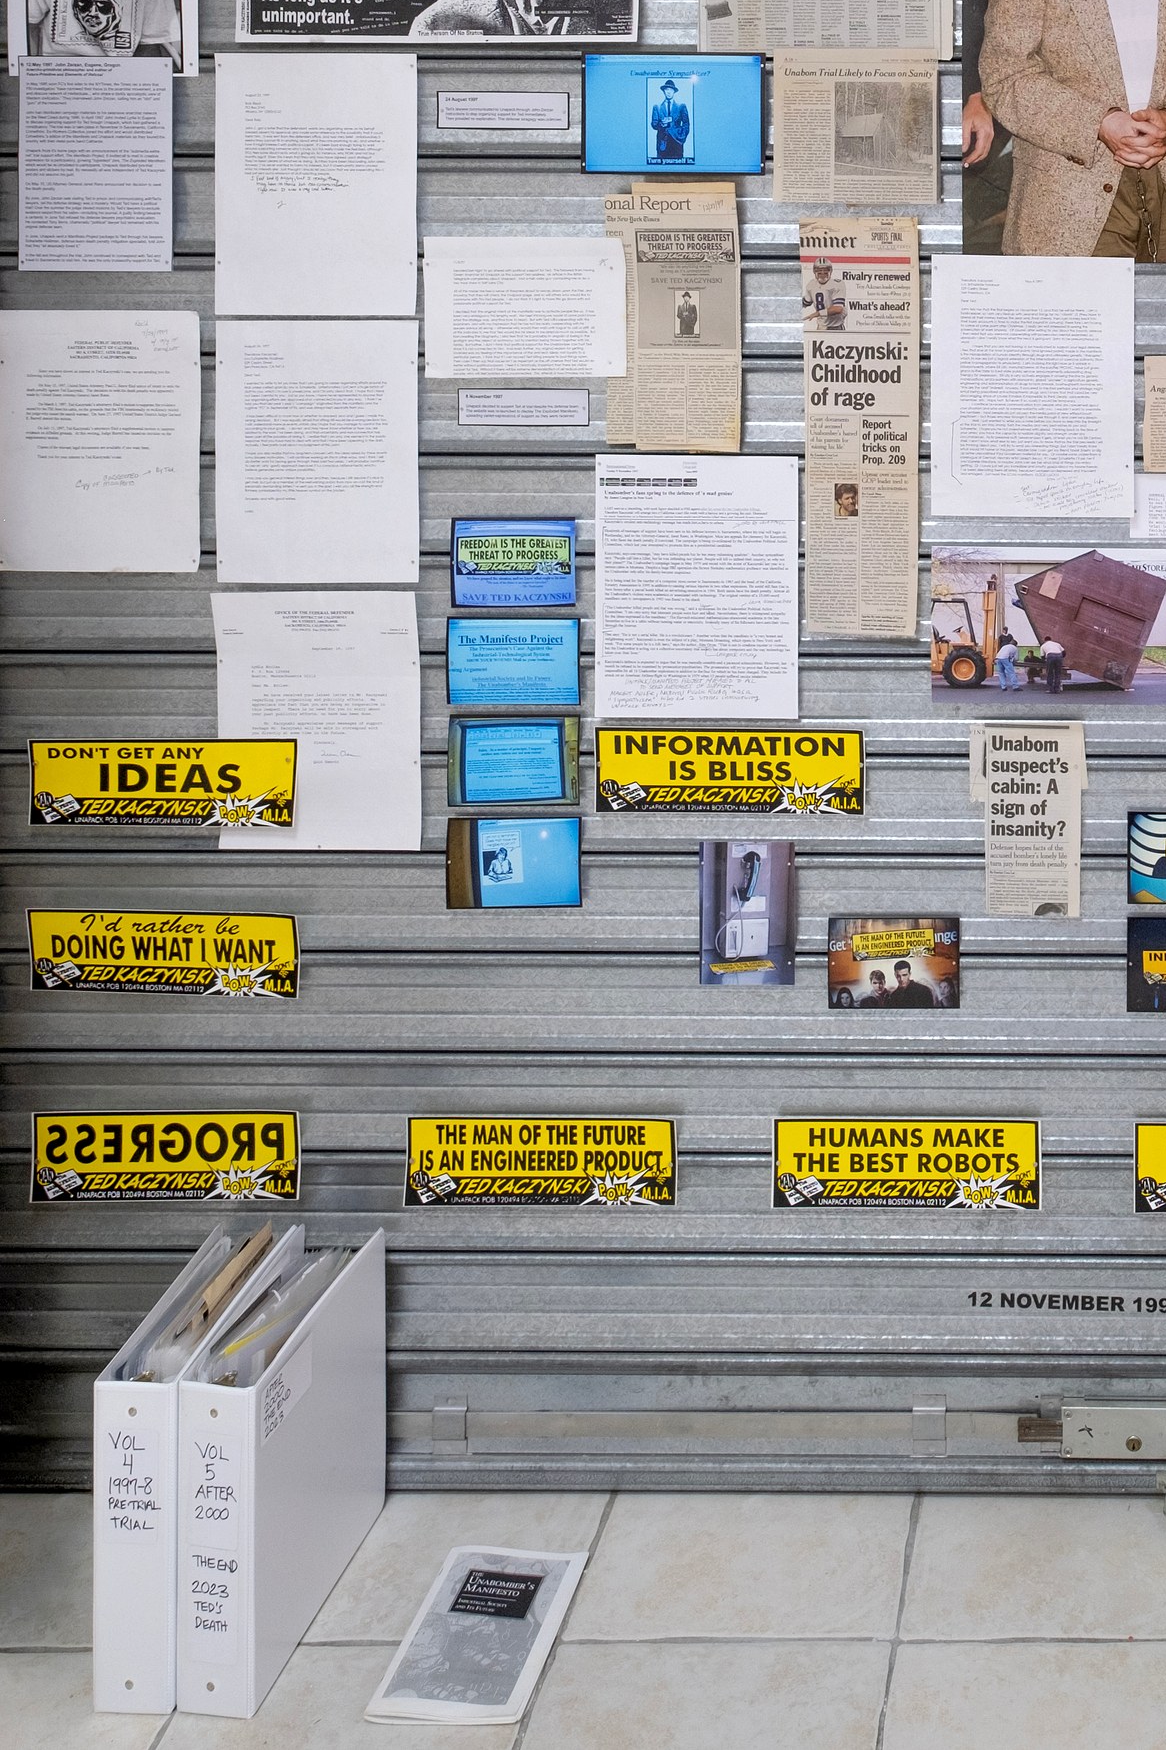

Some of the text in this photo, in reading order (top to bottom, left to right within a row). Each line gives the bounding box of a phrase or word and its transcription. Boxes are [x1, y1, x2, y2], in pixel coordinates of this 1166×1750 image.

[615, 735, 844, 756] INFORMATION
[992, 735, 1058, 752] Unabom
[48, 748, 203, 759] DON'T GET ANY
[670, 761, 791, 784] IS BLISS
[991, 758, 1068, 776] suspect's
[100, 764, 241, 794] IDEAS
[991, 778, 1059, 794] cabin: A
[991, 799, 1047, 818] sign of
[991, 820, 1066, 839] insanity?
[80, 914, 240, 935] I'd rather be
[51, 935, 275, 963] DOING WHAT I WANT
[436, 1125, 645, 1145] THE MAN OF THE FUTURE
[809, 1128, 1004, 1147] HUMANS MAKE
[419, 1149, 433, 1171] IS
[439, 1150, 464, 1174] AN
[471, 1150, 578, 1171] ENGINEERED
[794, 1153, 1019, 1175] THE BEST ROBOTS
[968, 1292, 992, 1307] 12
[1001, 1293, 1124, 1311] NOVEMBER
[108, 1431, 145, 1450] VOL
[123, 1454, 133, 1474] 4
[110, 1516, 154, 1530] TRIAL
